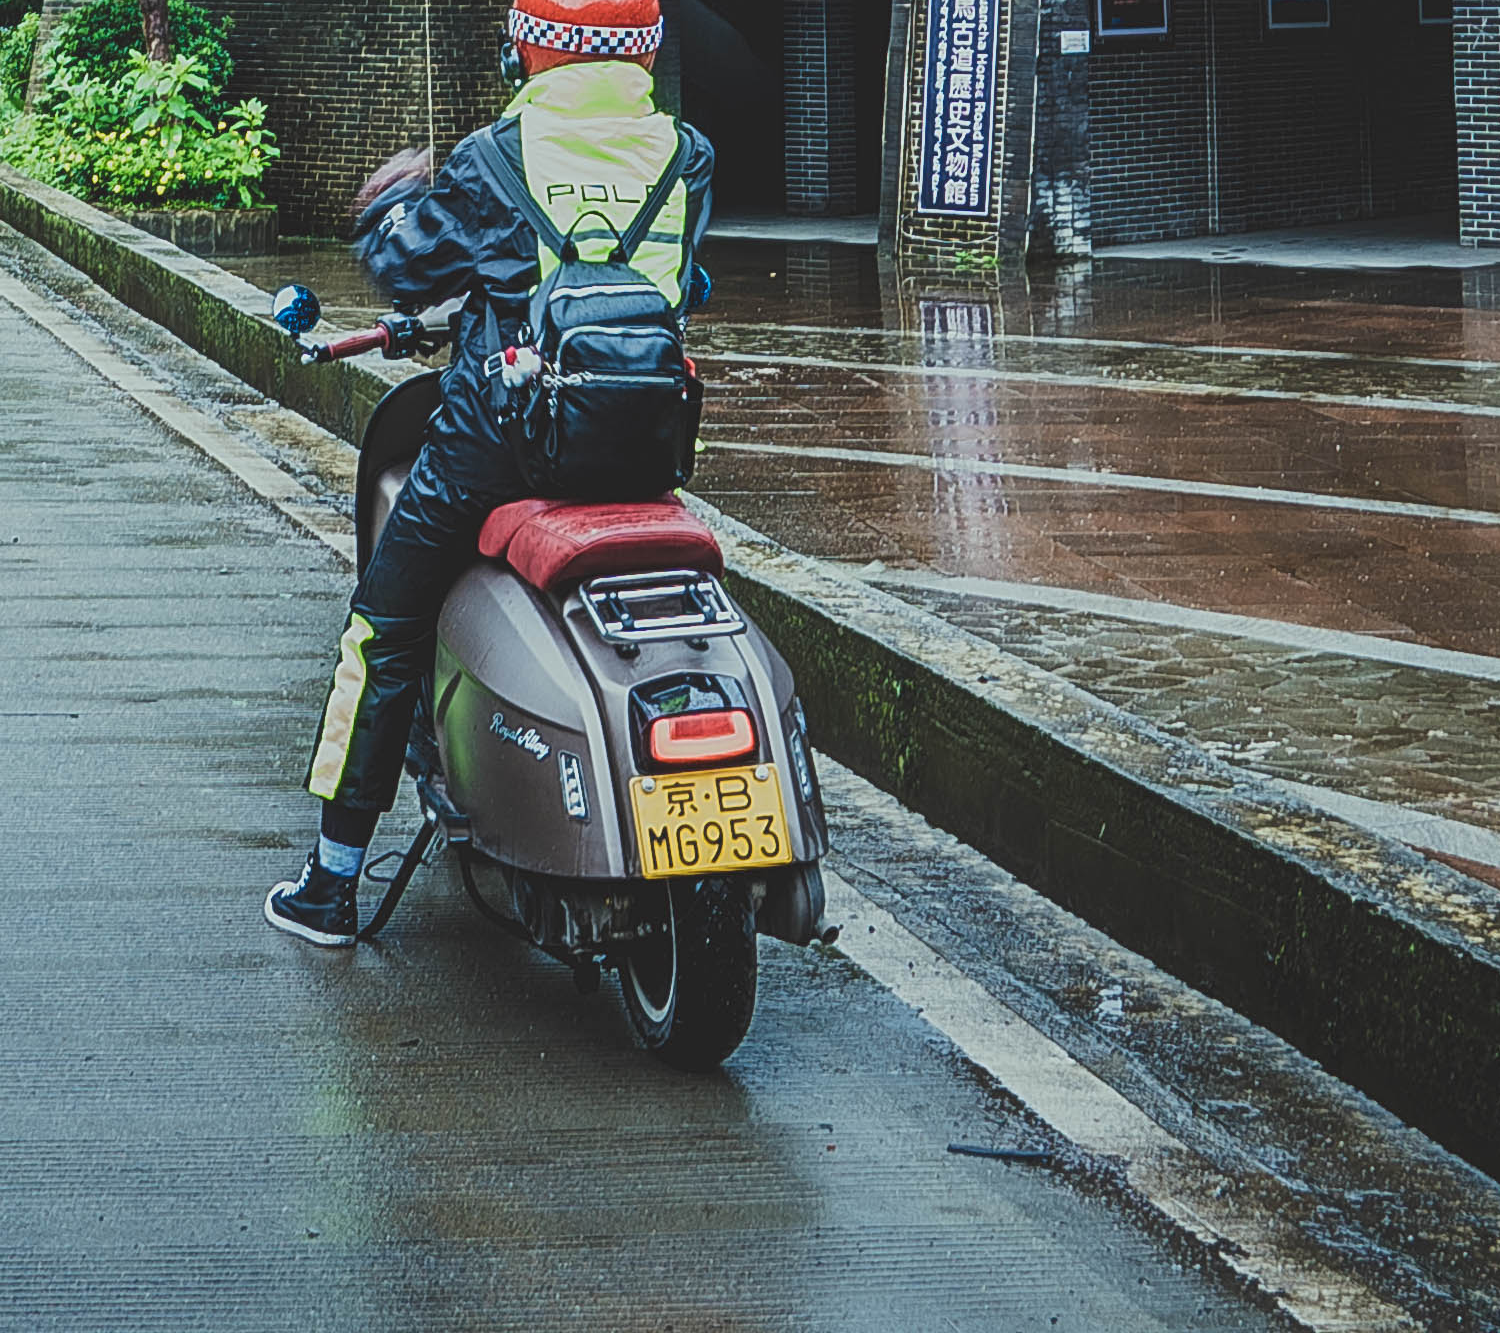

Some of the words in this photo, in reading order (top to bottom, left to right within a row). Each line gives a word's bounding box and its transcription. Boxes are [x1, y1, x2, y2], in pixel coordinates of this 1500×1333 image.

[974, 53, 989, 99] Horse
[972, 101, 986, 141] Road
[969, 143, 984, 207] Museum
[490, 712, 523, 741] Royal
[518, 728, 550, 760] Alloy
[648, 815, 780, 870] MG953
